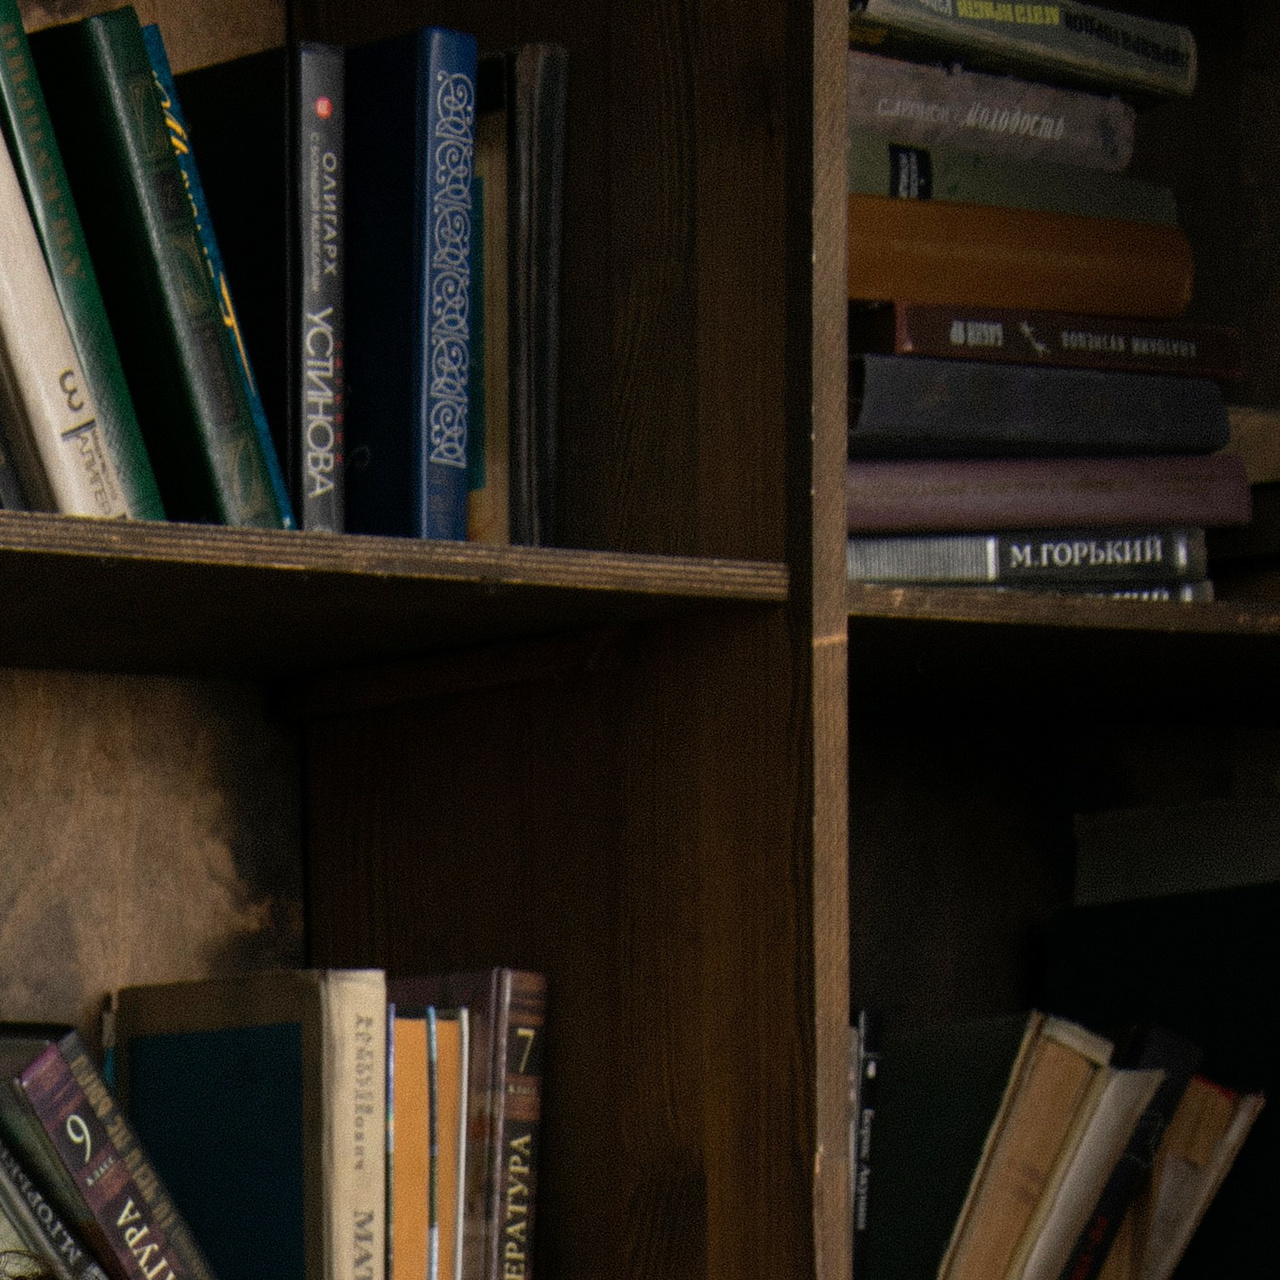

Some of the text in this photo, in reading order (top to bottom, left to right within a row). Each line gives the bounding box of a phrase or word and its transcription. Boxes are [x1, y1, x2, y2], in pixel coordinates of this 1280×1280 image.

[322, 152, 338, 275] ОЛИГАРХ
[306, 307, 335, 499] УСТИНОВА
[1010, 535, 1163, 568] М.ГОРЬКИЙ
[517, 1028, 536, 1073] 7
[65, 1113, 94, 1163] 9
